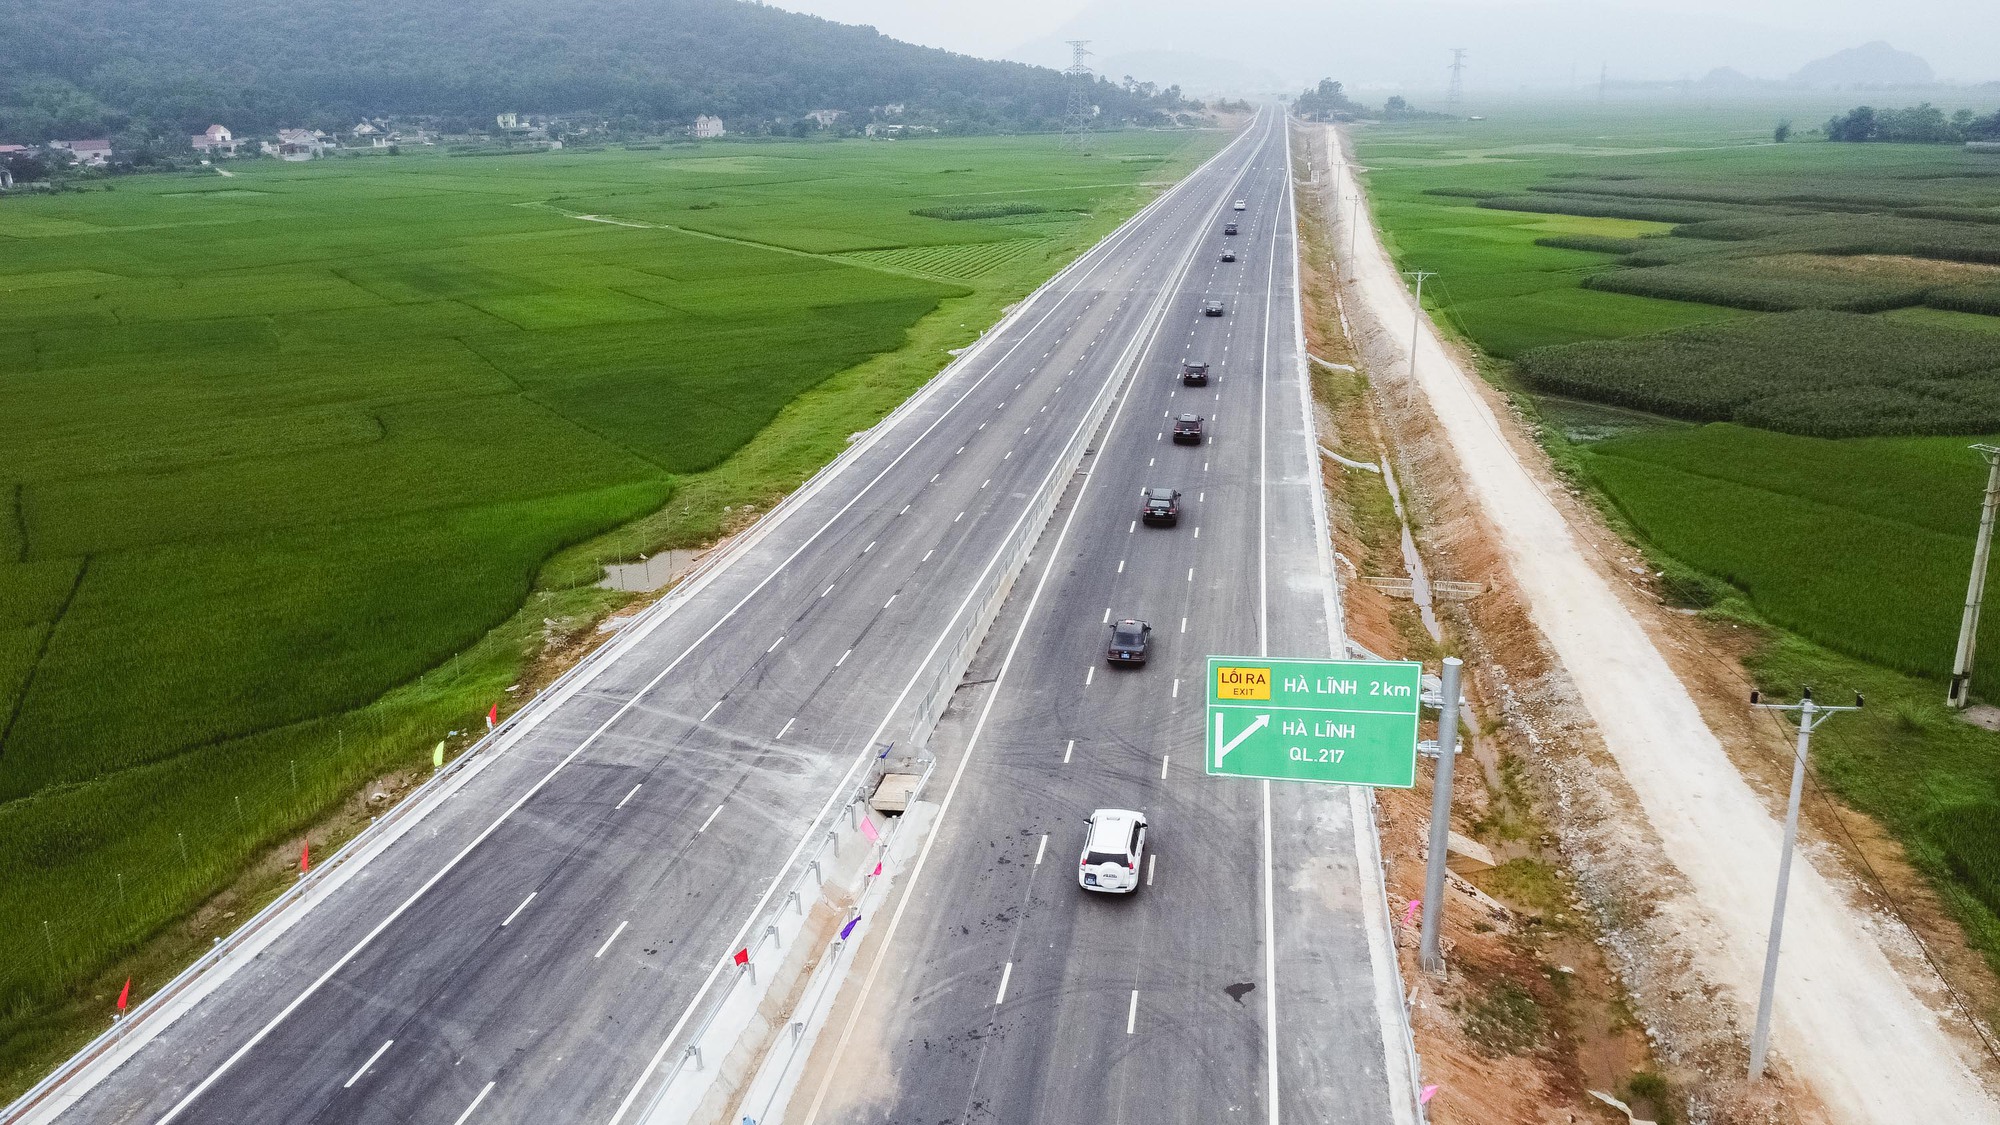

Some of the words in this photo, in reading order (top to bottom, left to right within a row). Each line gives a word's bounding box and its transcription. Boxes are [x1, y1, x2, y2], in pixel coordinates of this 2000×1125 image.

[1221, 668, 1242, 684] LỐI
[1245, 673, 1266, 685] RA
[1284, 674, 1309, 692] HÀ
[1316, 676, 1357, 695] LĨNH
[1233, 687, 1255, 696] EXIT
[1282, 718, 1308, 737] HÀ
[1314, 720, 1356, 739] LĨNH
[1289, 746, 1345, 764] QL.217
